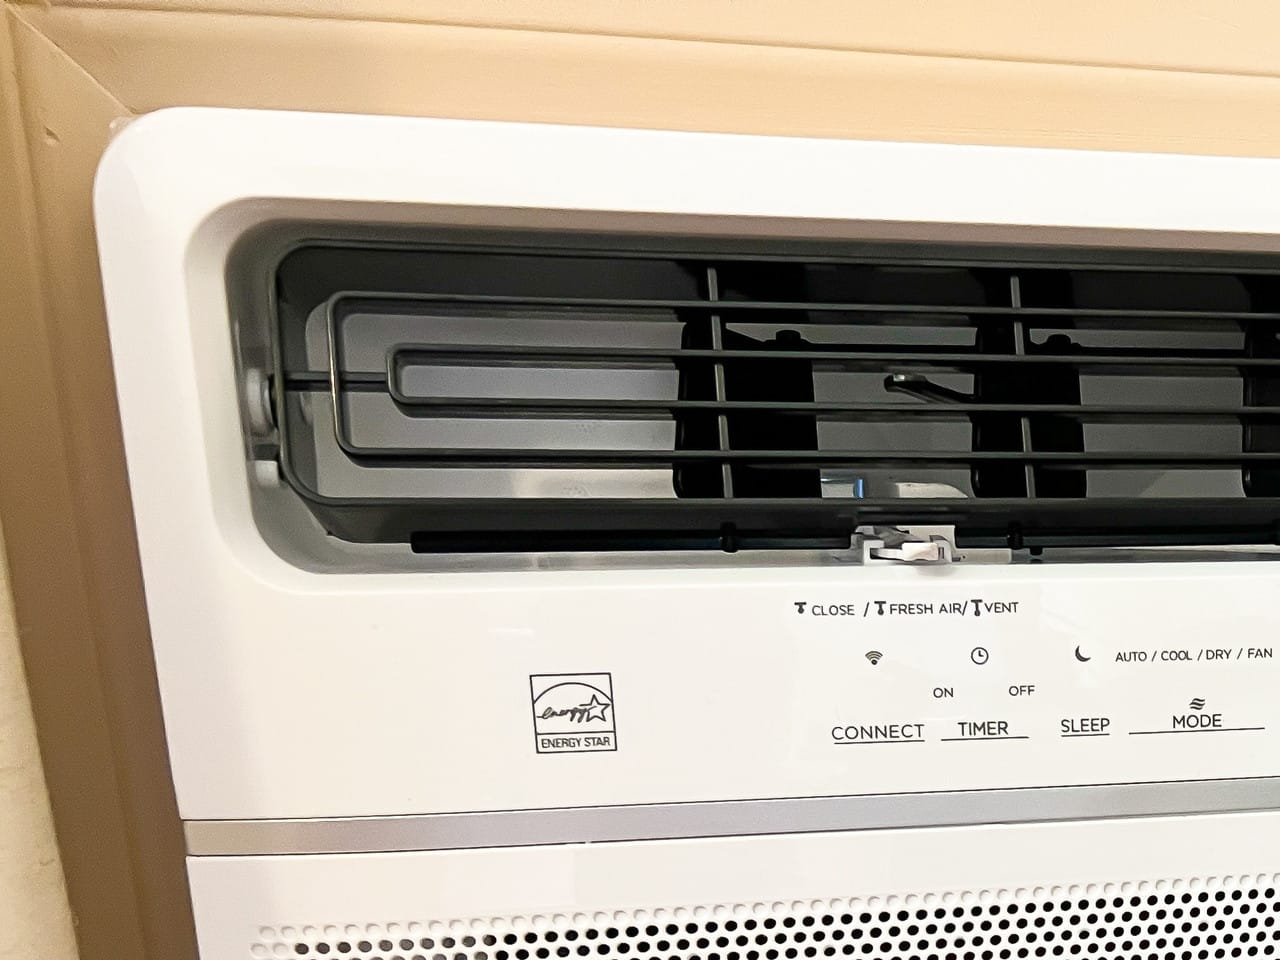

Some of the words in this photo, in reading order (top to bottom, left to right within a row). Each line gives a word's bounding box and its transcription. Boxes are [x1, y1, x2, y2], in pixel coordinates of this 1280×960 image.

[811, 604, 856, 617] CLOSE
[889, 603, 934, 616] FRESH
[984, 601, 1020, 615] VENT
[1114, 650, 1148, 663] AUTO
[1160, 649, 1193, 662] COOL
[1205, 648, 1233, 661] DRY
[1247, 647, 1273, 660] FAN
[932, 687, 955, 699] ON
[1008, 684, 1036, 697] OFF
[956, 720, 1009, 737] TIMER
[1060, 717, 1111, 734] SLEEP
[1172, 713, 1223, 729] MODE
[831, 723, 926, 741] CONNECT
[540, 737, 582, 749] ENERGY
[583, 735, 612, 748] STAR
